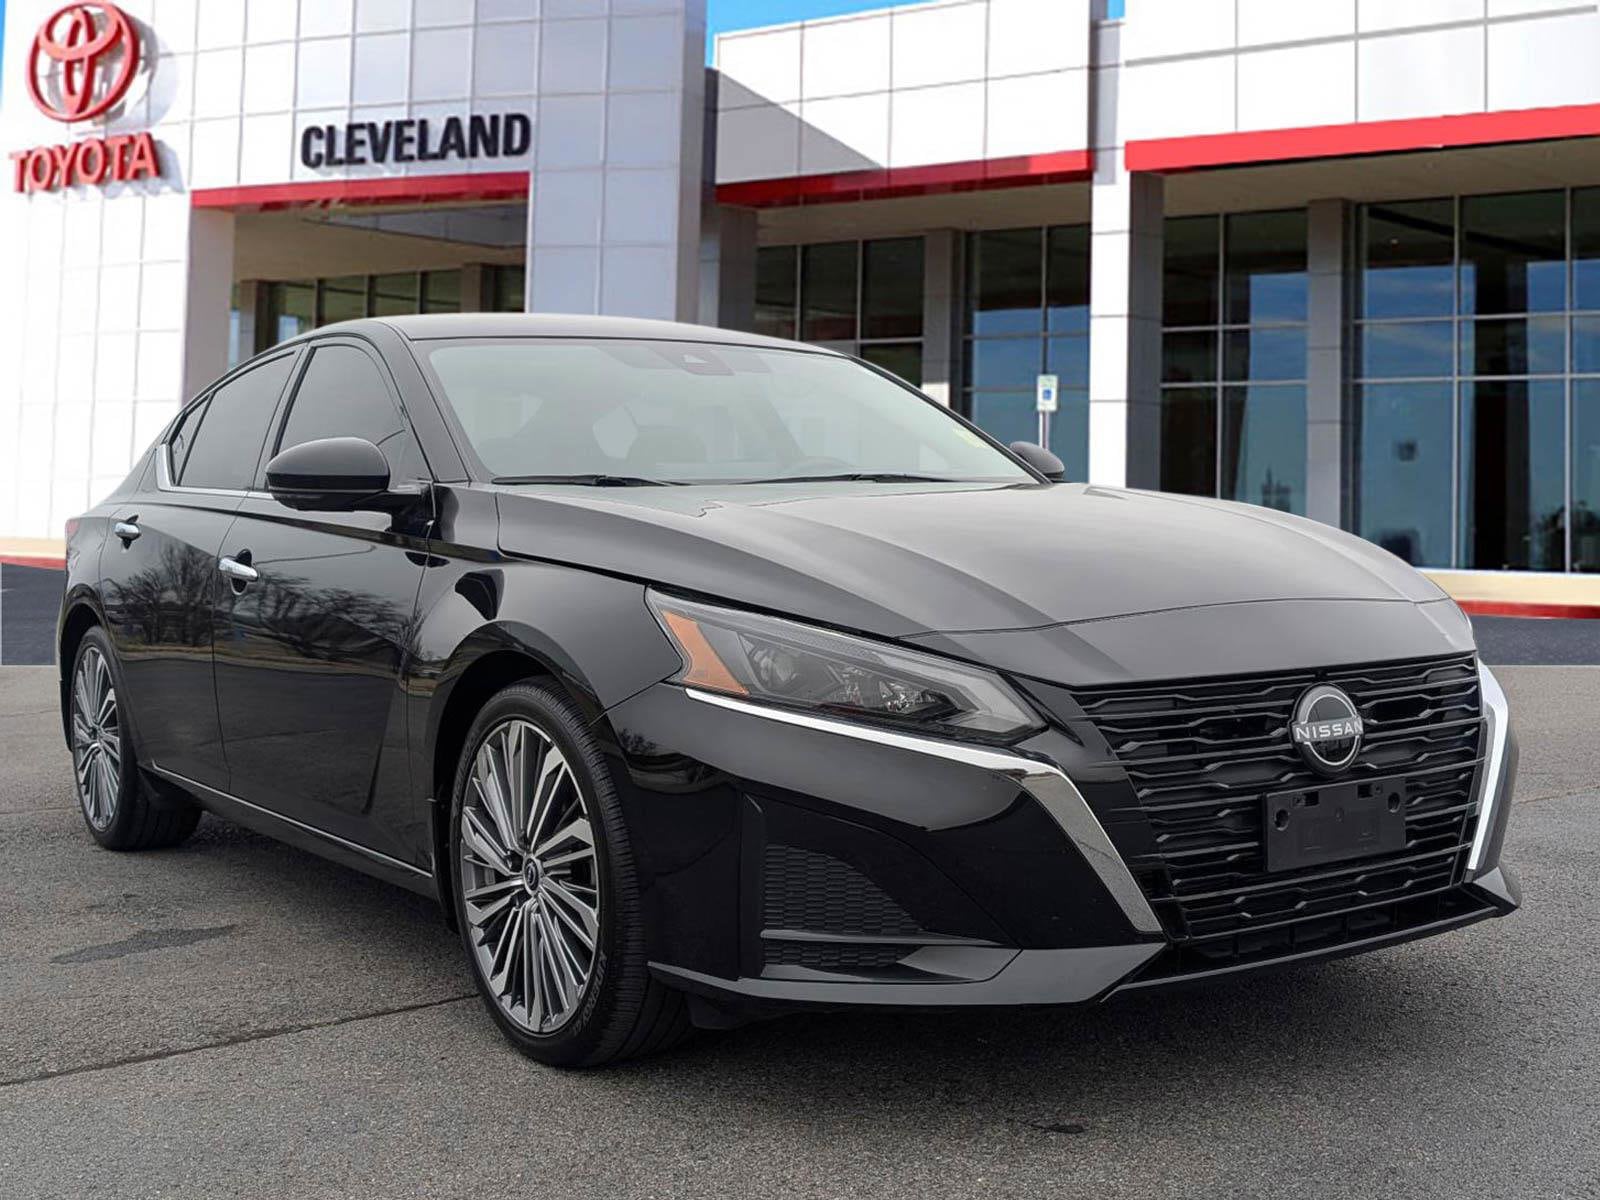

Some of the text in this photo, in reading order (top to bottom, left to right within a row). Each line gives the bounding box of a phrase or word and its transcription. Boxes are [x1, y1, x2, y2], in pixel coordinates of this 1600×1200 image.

[9, 131, 161, 193] TOYOTA
[301, 113, 532, 169] CLEVELAND
[1296, 721, 1363, 739] NISSAN
